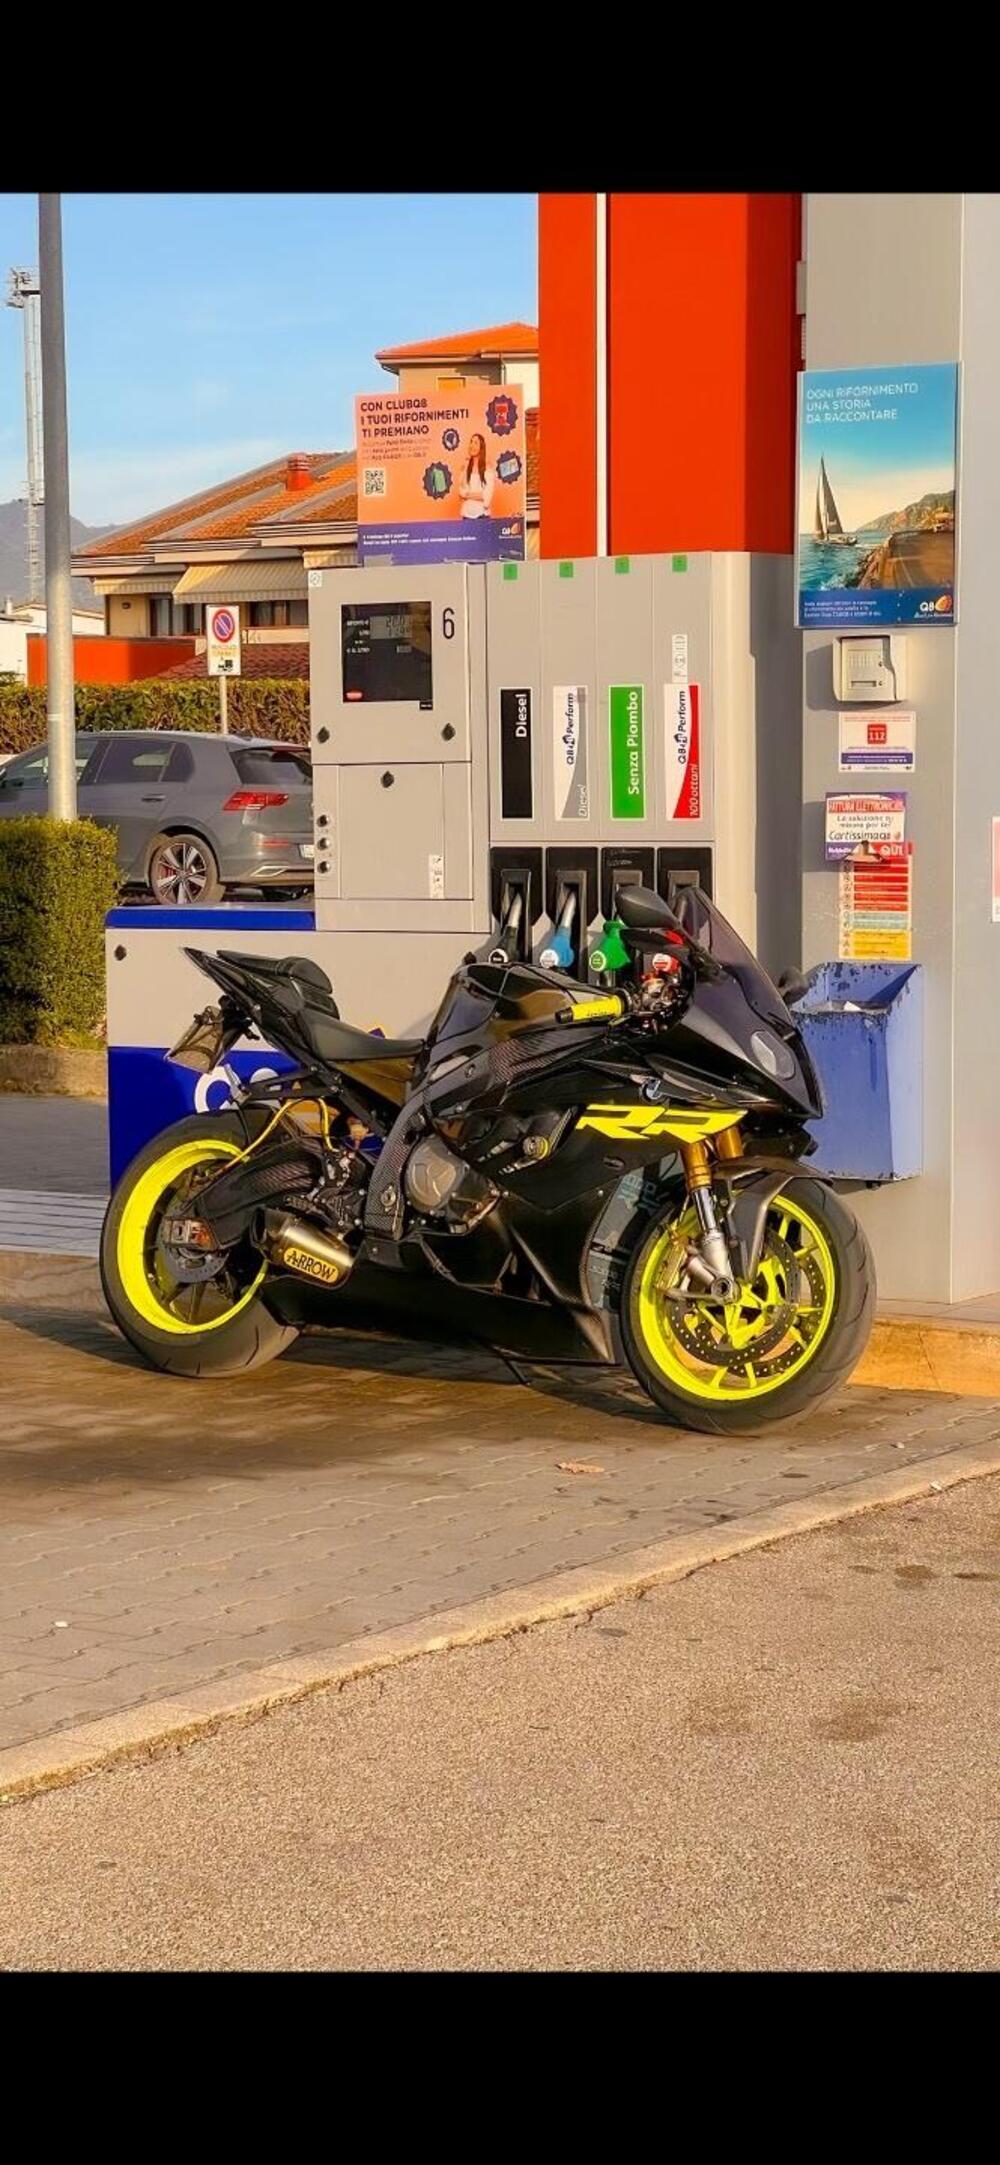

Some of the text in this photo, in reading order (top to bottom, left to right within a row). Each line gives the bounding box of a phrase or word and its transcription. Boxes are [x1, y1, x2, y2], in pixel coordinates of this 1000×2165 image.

[806, 382, 919, 400] OGNI RIFORNIMENTO
[360, 398, 428, 412] CON CLUBQ8
[806, 399, 872, 412] UNA STORIA
[366, 414, 392, 425] TUOI
[394, 408, 469, 424] RIFORNIMENTI
[806, 408, 898, 424] DA RACCONTARE
[361, 424, 430, 438] TI PREMIANO
[919, 601, 935, 612] Q8
[442, 607, 455, 639] 6
[515, 693, 528, 738] Diesel
[626, 691, 640, 795] Senza Piombo
[868, 731, 886, 741] 112
[575, 1103, 748, 1144] RR
[287, 1250, 336, 1280] ARROW
